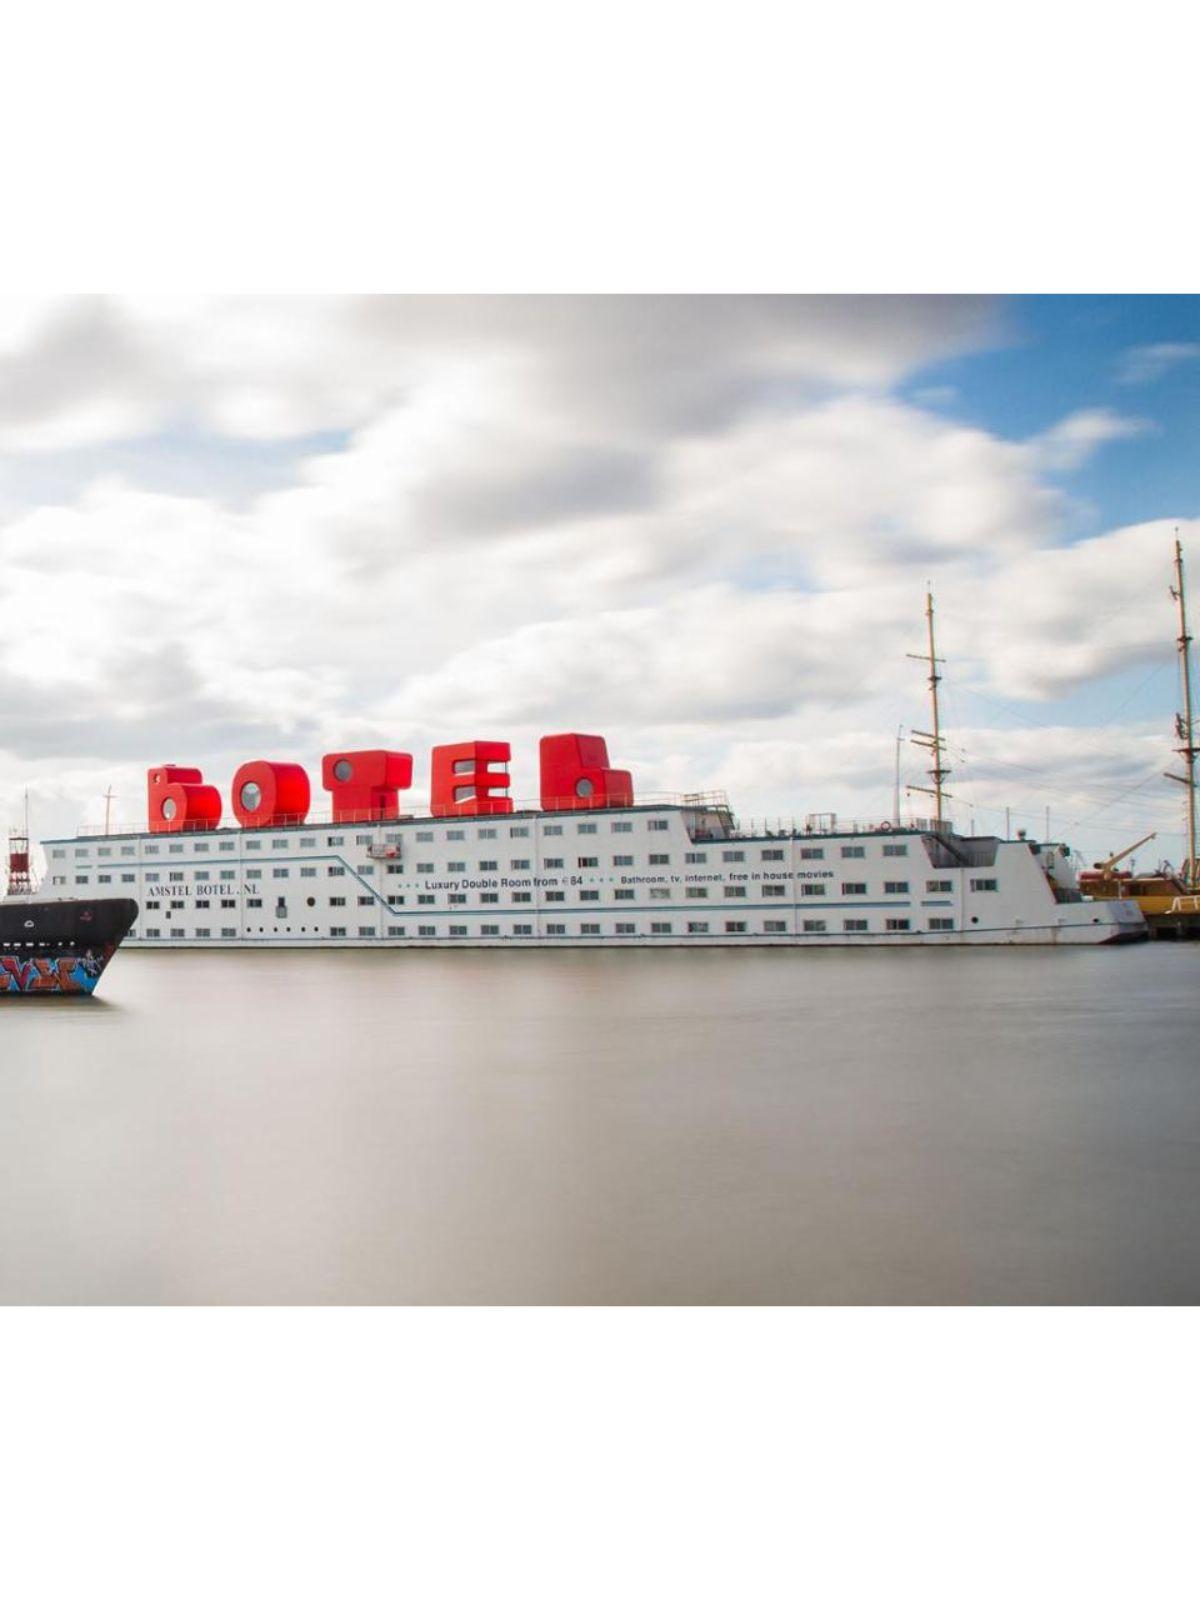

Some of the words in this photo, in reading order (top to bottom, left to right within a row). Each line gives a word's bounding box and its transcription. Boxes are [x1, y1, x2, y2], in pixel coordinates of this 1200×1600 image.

[729, 872, 748, 880] free
[751, 872, 760, 880] in
[763, 871, 794, 880] house
[797, 870, 834, 879] movies
[425, 879, 459, 891] Luxury
[462, 877, 498, 889] Double
[500, 877, 531, 888] Room
[533, 877, 558, 887] from
[148, 885, 192, 897] AMSTEL
